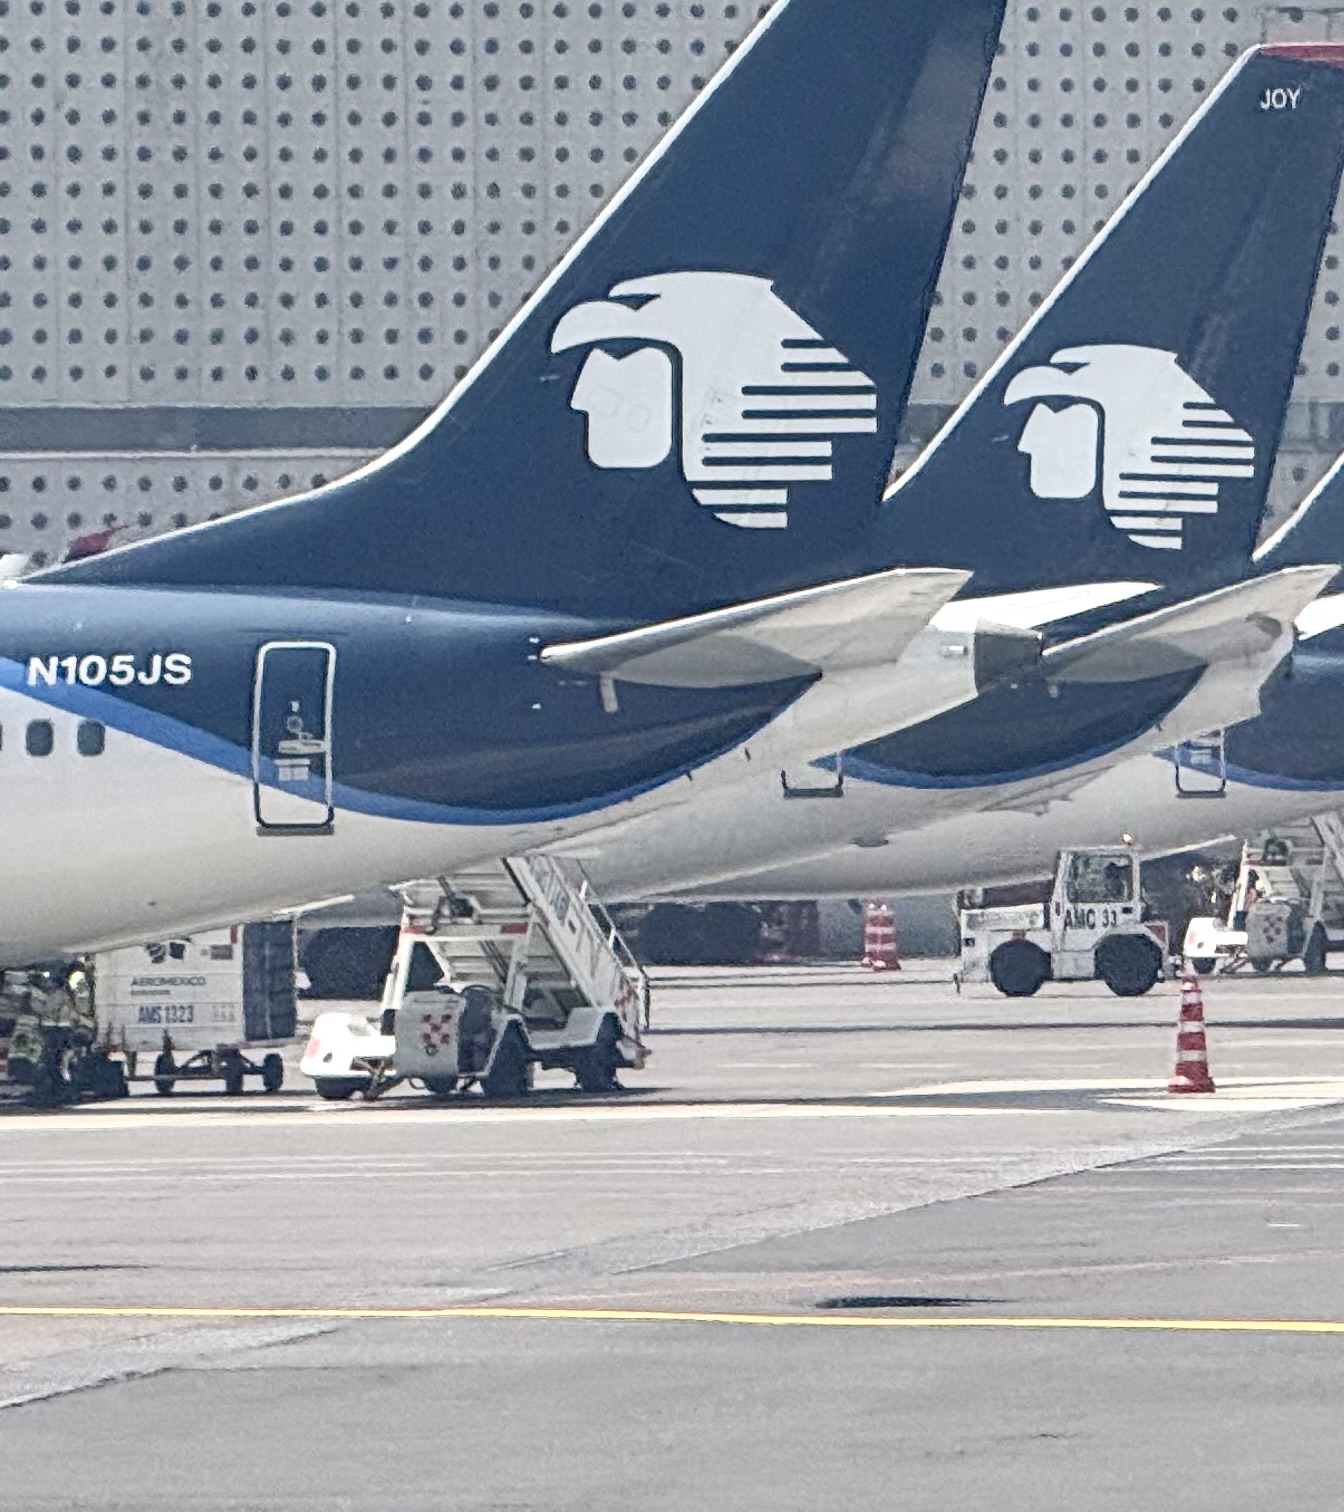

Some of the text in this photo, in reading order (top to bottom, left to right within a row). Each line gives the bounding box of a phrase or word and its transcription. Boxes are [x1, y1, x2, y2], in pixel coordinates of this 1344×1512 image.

[1260, 86, 1302, 110] JOY
[25, 653, 193, 686] N105JS
[1063, 907, 1117, 931] AMC 33
